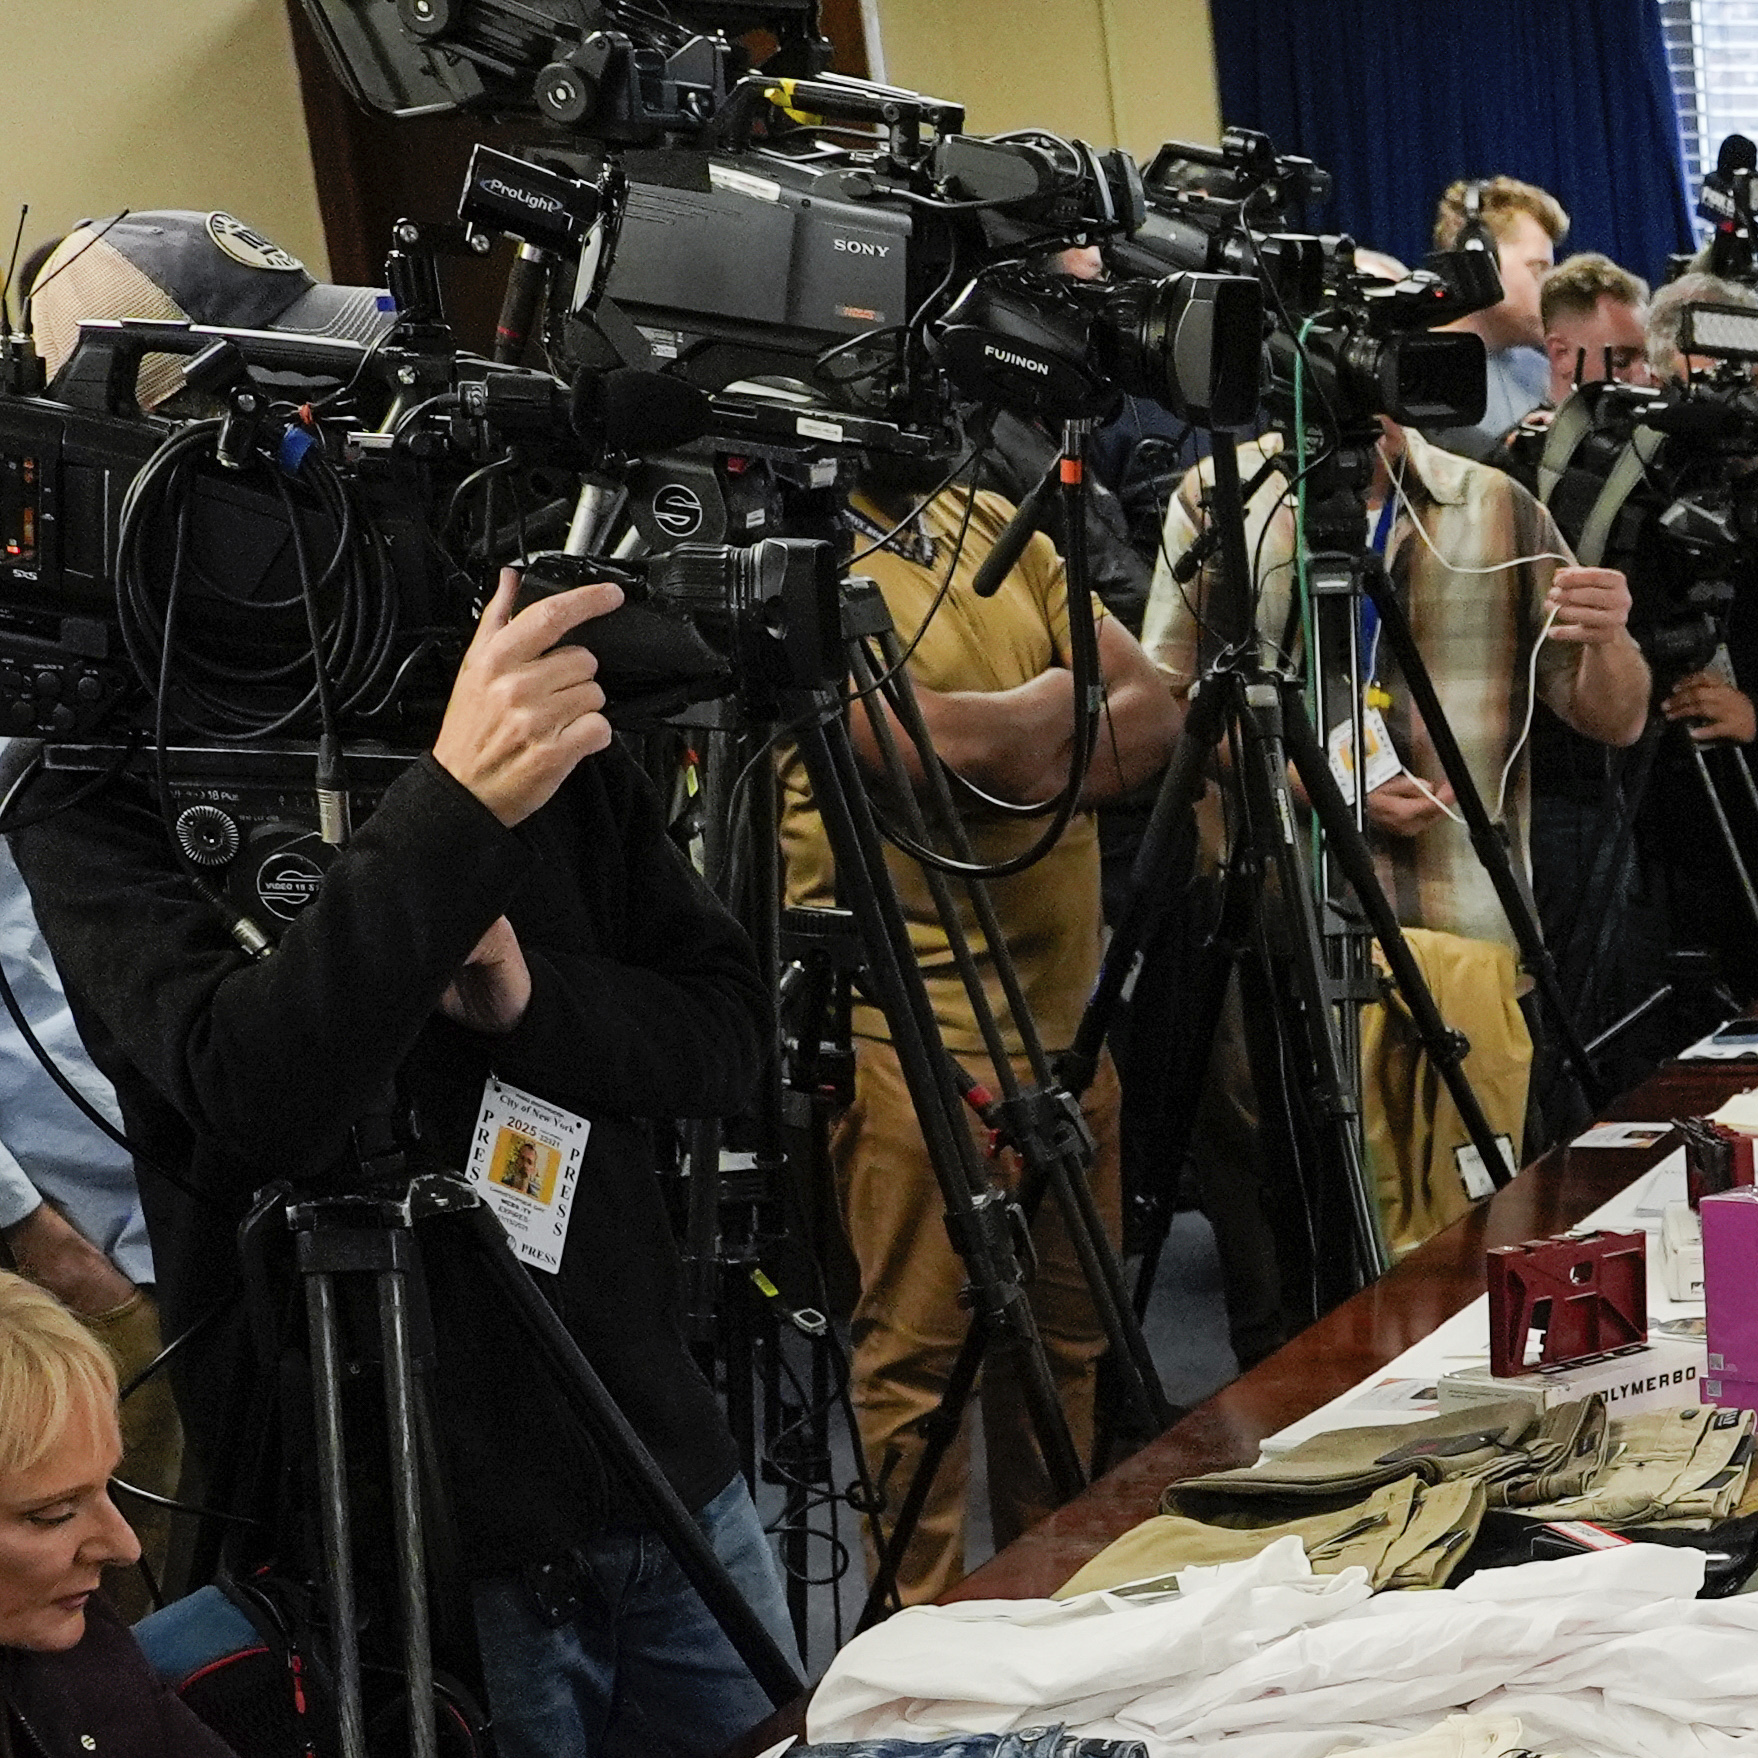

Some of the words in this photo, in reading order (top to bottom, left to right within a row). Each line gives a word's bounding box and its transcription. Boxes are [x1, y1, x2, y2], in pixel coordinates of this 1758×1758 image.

[490, 178, 555, 213] ProLight
[833, 238, 890, 258] SONY
[984, 344, 1049, 375] FUJINON
[500, 1094, 518, 1110] City
[521, 1104, 531, 1113] of
[507, 1116, 537, 1137] 2025
[552, 1148, 580, 1237] PRESS
[521, 1243, 557, 1266] PRESS
